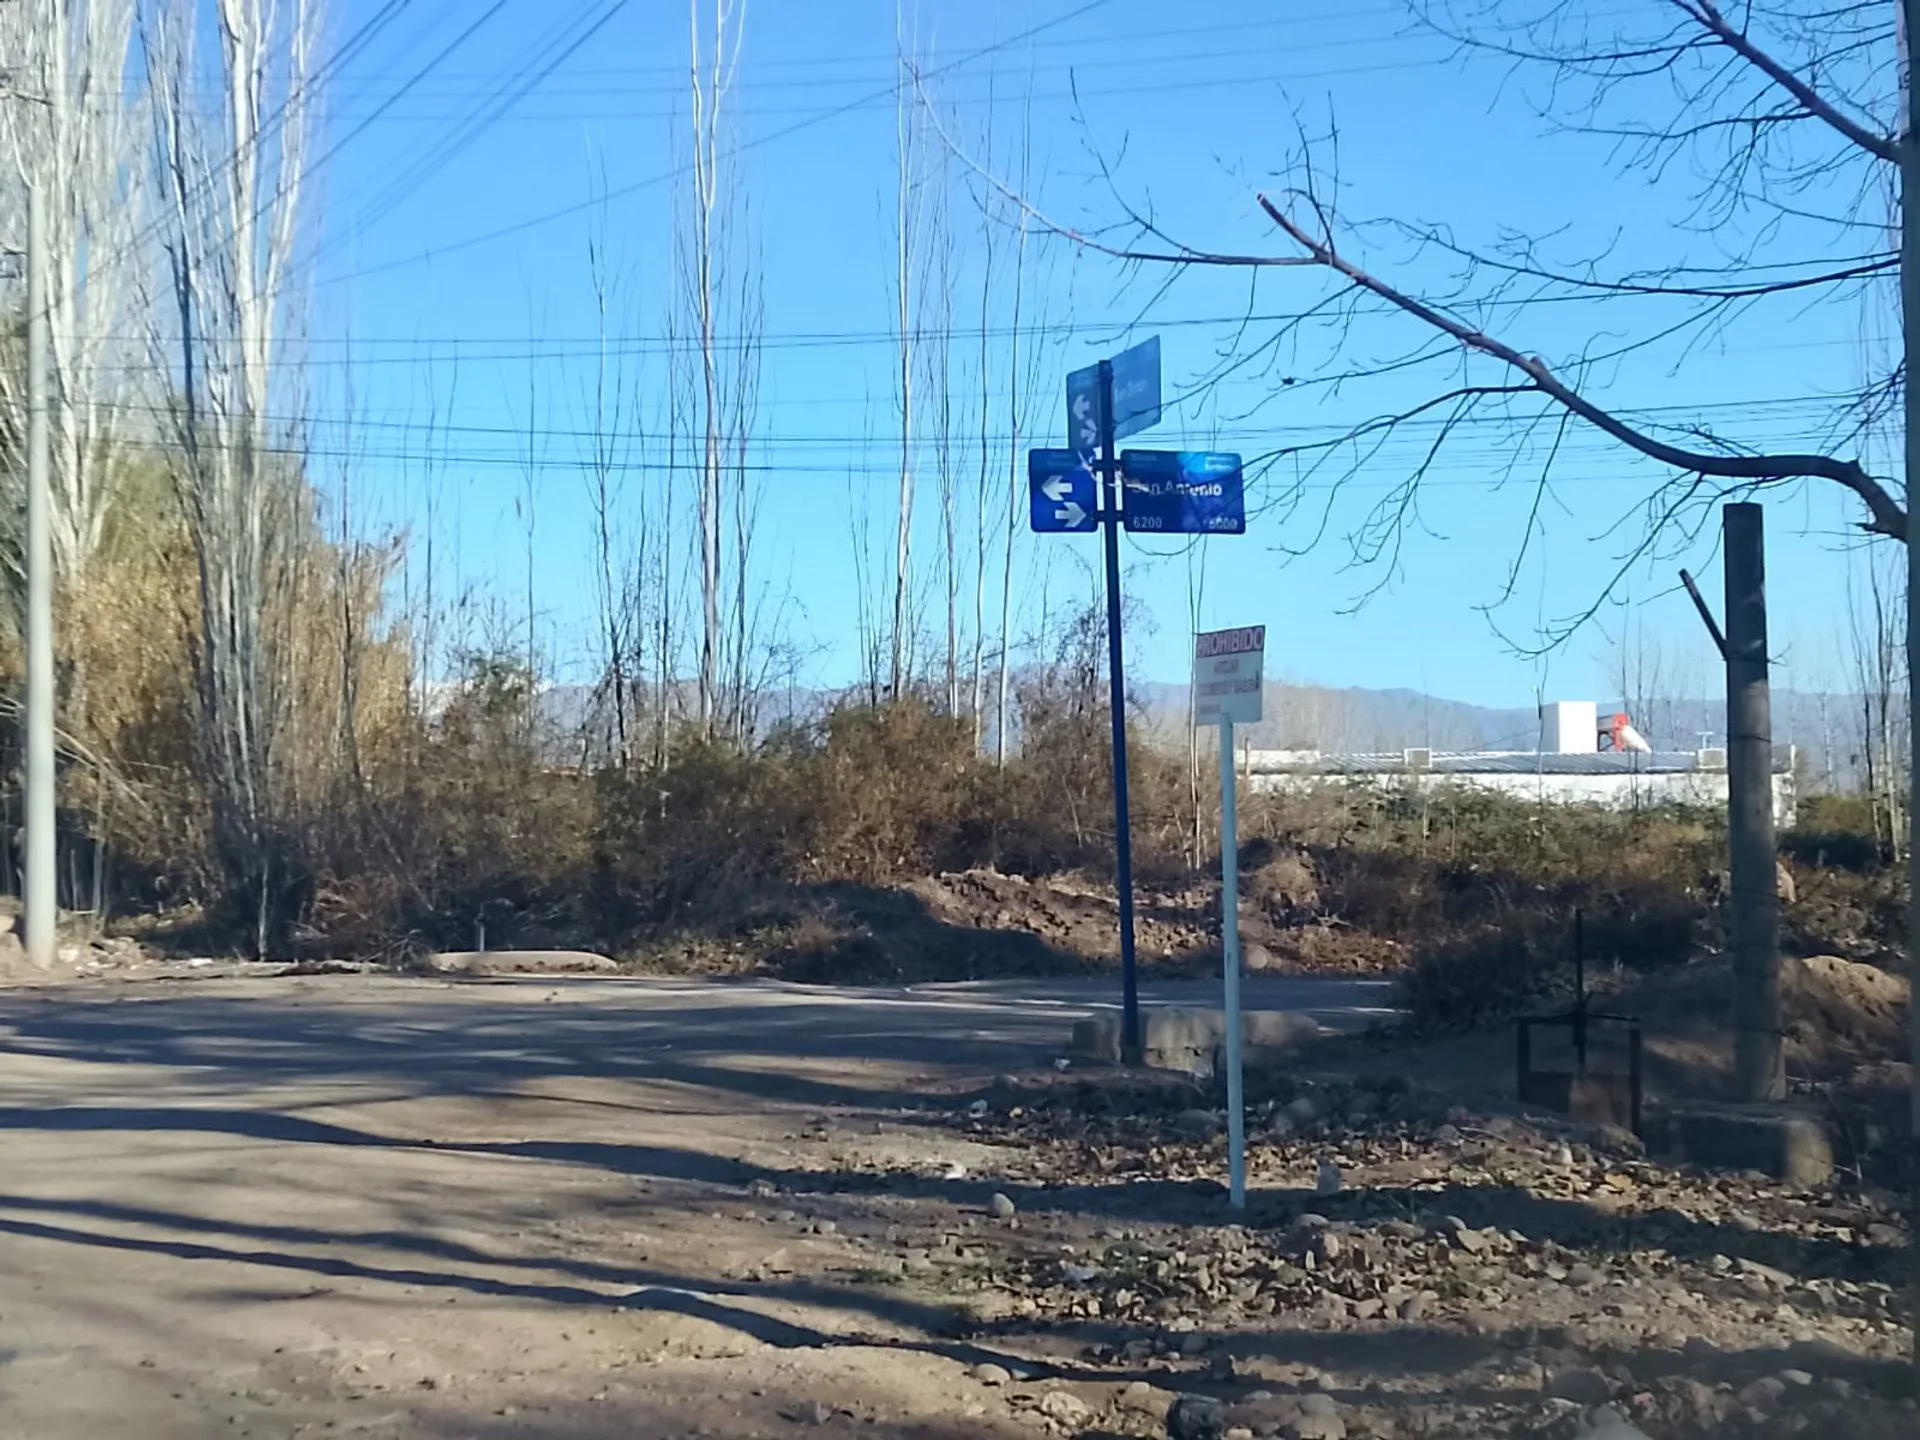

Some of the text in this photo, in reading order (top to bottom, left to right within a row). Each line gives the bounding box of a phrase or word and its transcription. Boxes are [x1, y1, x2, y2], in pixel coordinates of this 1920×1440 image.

[1164, 478, 1222, 497] Antonio
[1133, 516, 1162, 529] 6200
[1197, 628, 1263, 656] PROHIBIDO
